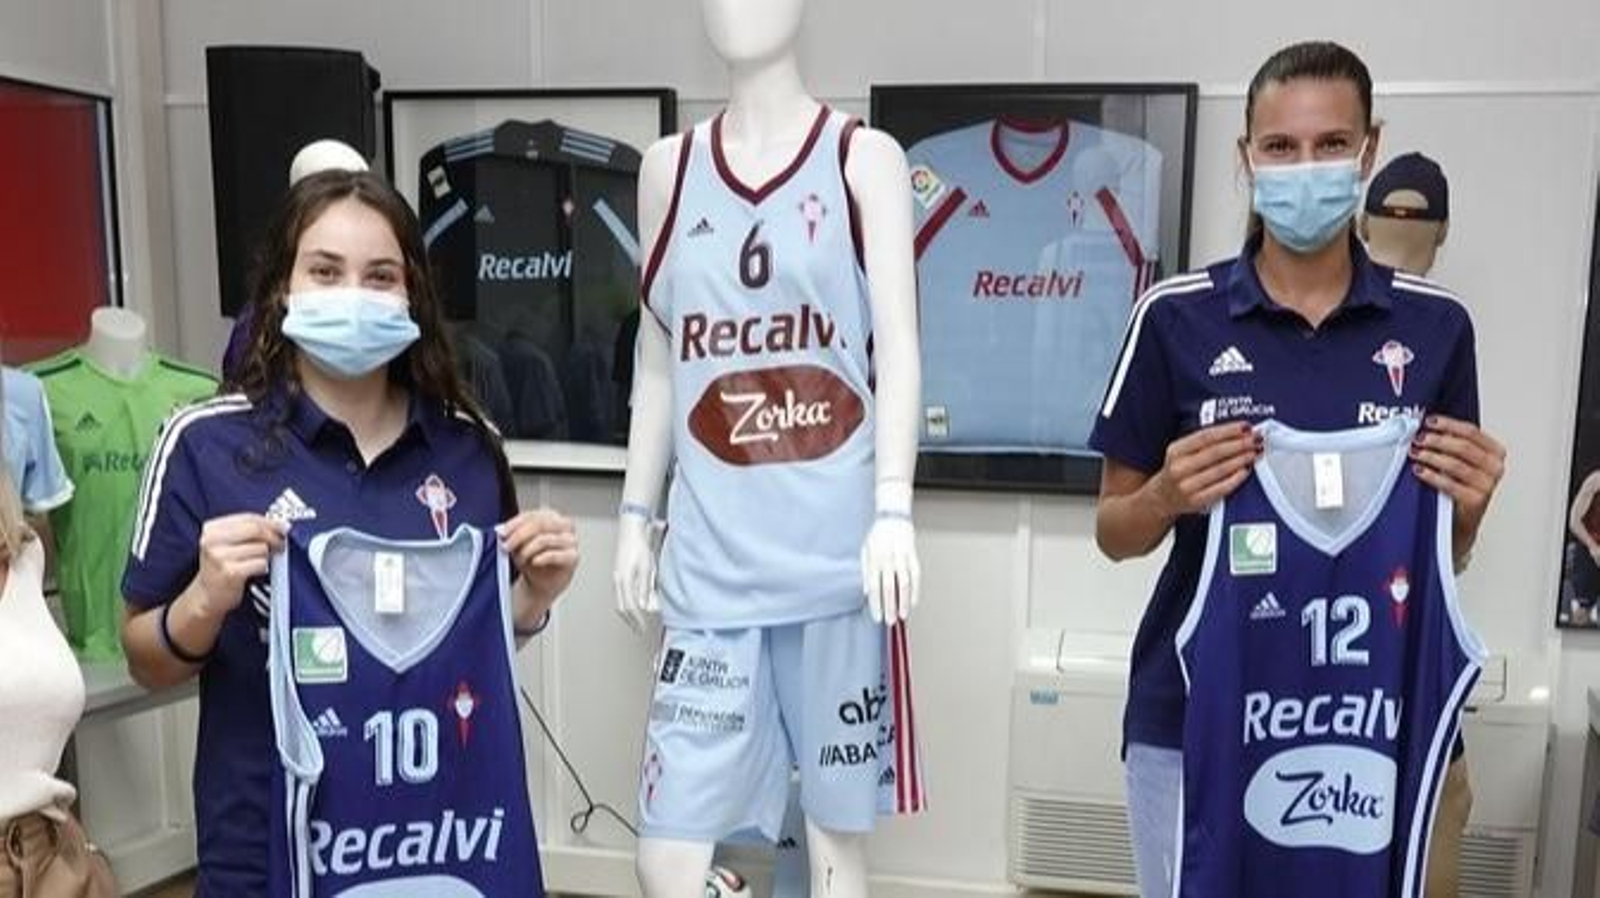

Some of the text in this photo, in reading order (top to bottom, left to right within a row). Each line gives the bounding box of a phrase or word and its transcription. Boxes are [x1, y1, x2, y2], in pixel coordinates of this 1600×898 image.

[478, 250, 573, 280] Recalvi
[738, 219, 772, 289] 6
[972, 268, 1083, 298] Recalvi
[680, 304, 847, 362] Recalv
[720, 390, 830, 444] Zorka
[1301, 595, 1371, 667] 12
[1243, 689, 1402, 744] Recalv
[362, 708, 439, 786] 10
[1275, 772, 1385, 826] Zorka
[309, 808, 505, 875] Recalvi
